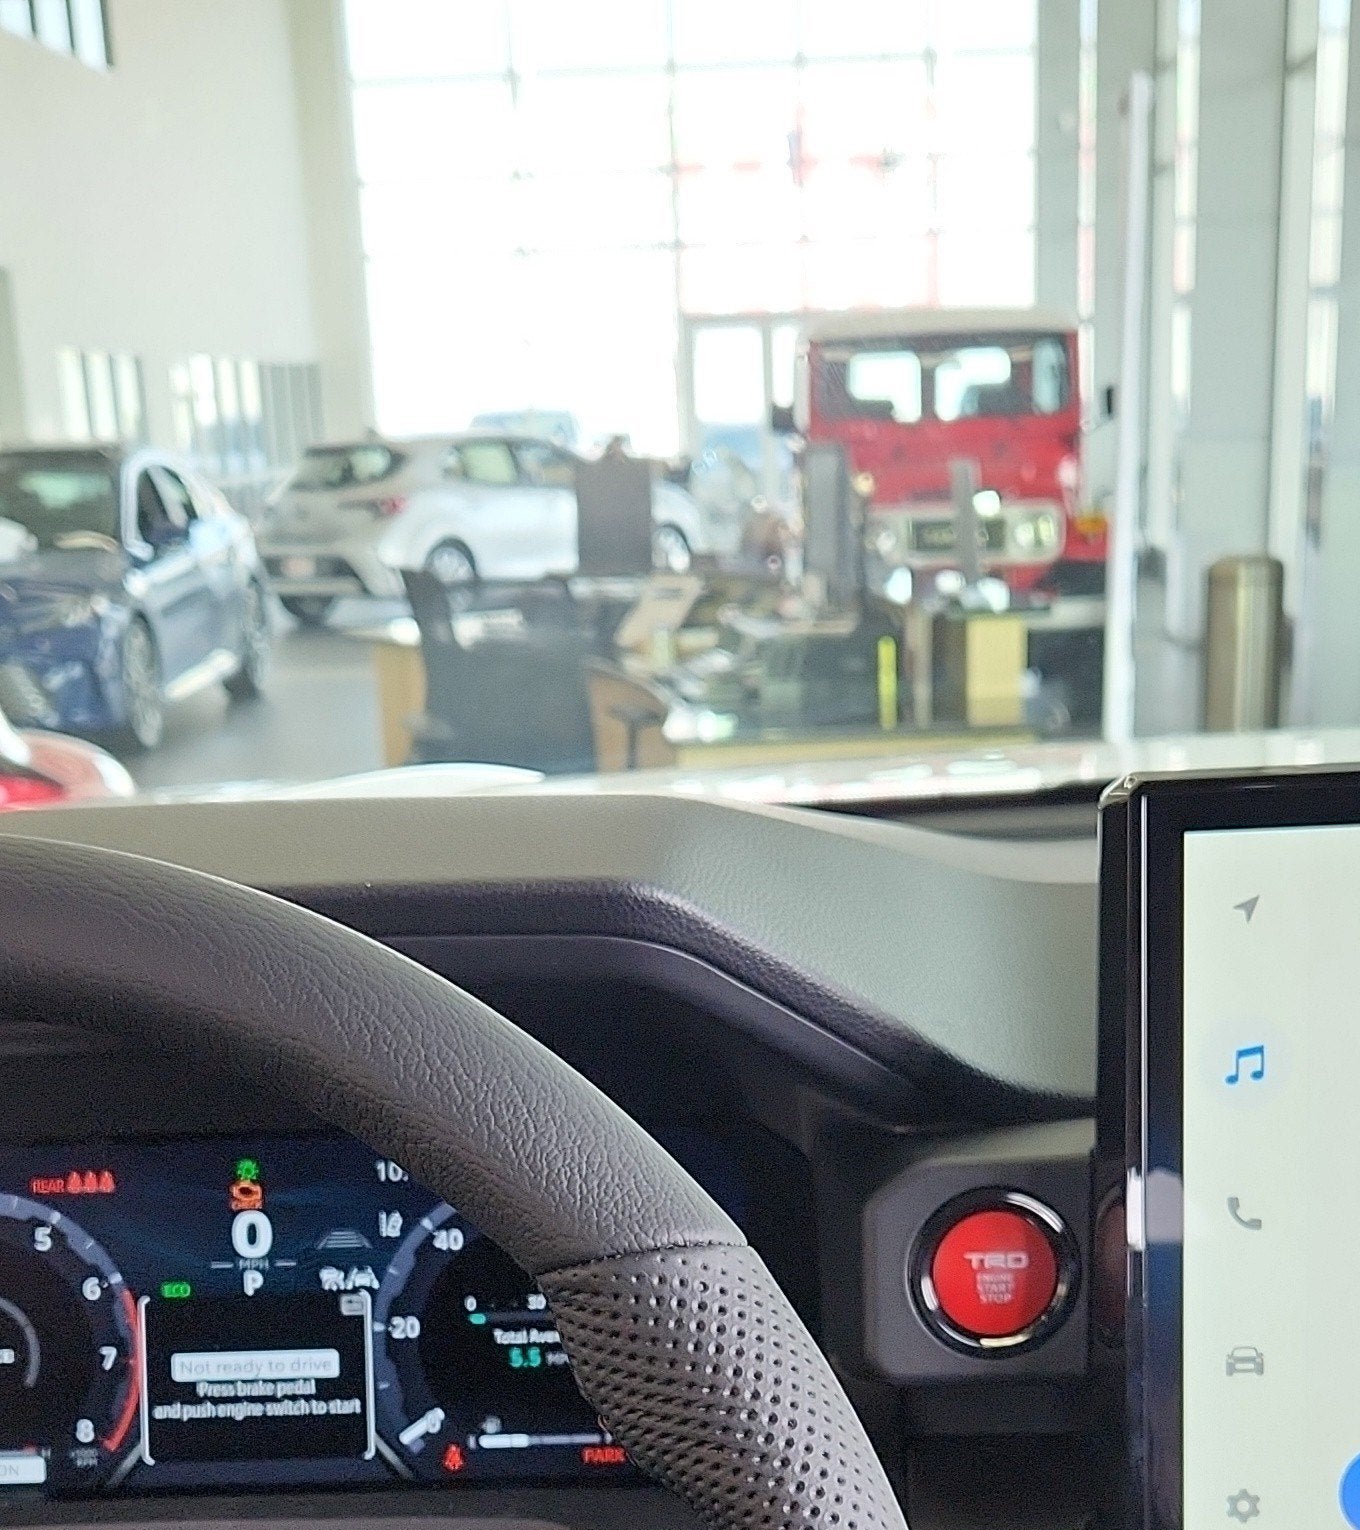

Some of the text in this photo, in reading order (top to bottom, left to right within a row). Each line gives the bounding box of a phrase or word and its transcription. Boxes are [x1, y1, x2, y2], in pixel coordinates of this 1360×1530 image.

[34, 1226, 53, 1252] 5
[231, 1209, 273, 1258] 0
[82, 1276, 101, 1301] 6
[243, 1270, 264, 1297] P
[391, 1315, 421, 1339] 20
[99, 1346, 118, 1371] 7
[180, 1357, 332, 1378] Not ready to drive
[196, 1378, 316, 1398] Press brake pedal
[152, 1398, 361, 1421] and push engine switch to start
[76, 1418, 95, 1443] 8
